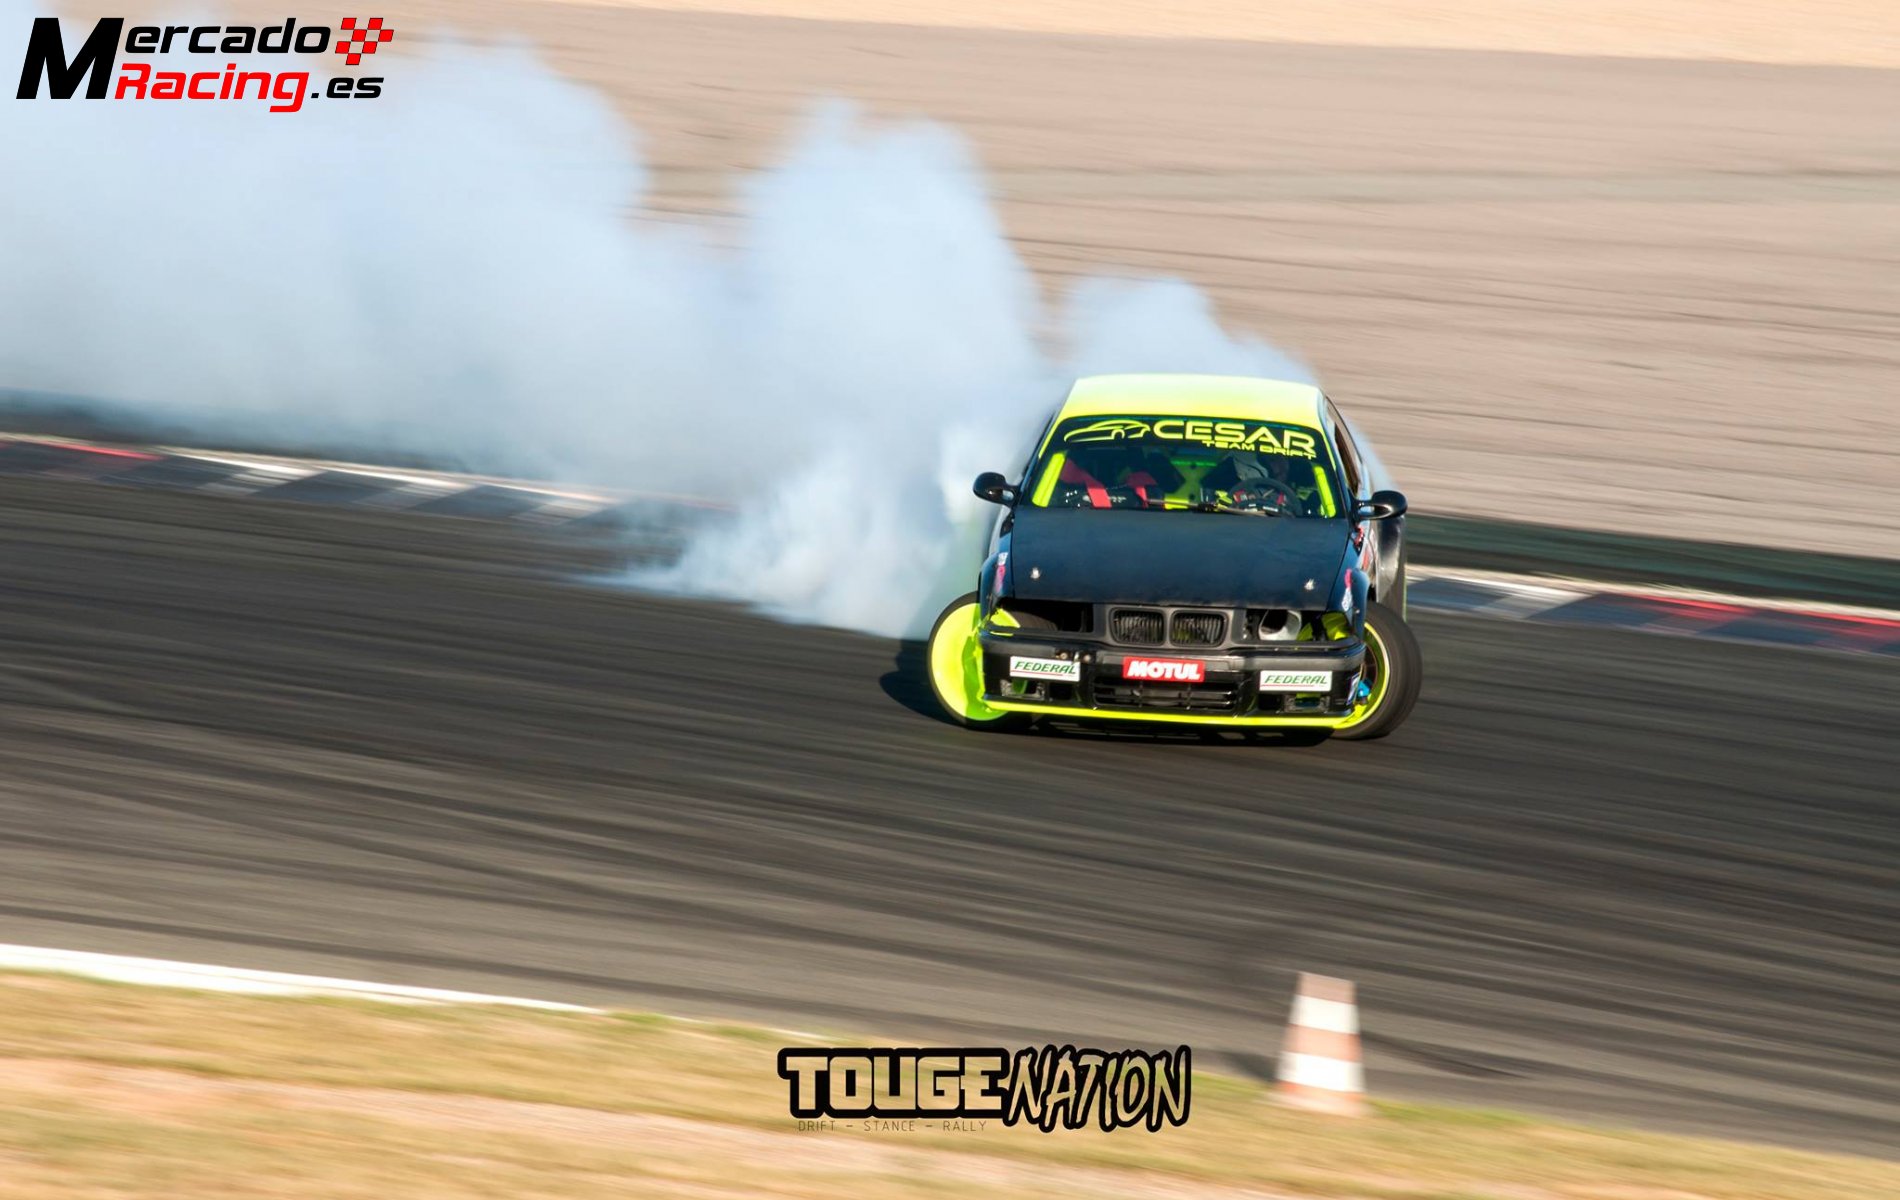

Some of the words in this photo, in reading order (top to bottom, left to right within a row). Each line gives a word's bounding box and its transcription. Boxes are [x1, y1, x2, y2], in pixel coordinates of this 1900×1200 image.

[1153, 420, 1316, 455] CESAR
[1202, 440, 1255, 451] TEAM
[1259, 445, 1317, 460] DRIFT
[1014, 660, 1077, 675] FEDERAL
[1127, 660, 1201, 680] MOTUL
[1264, 674, 1328, 685] FEDERAL
